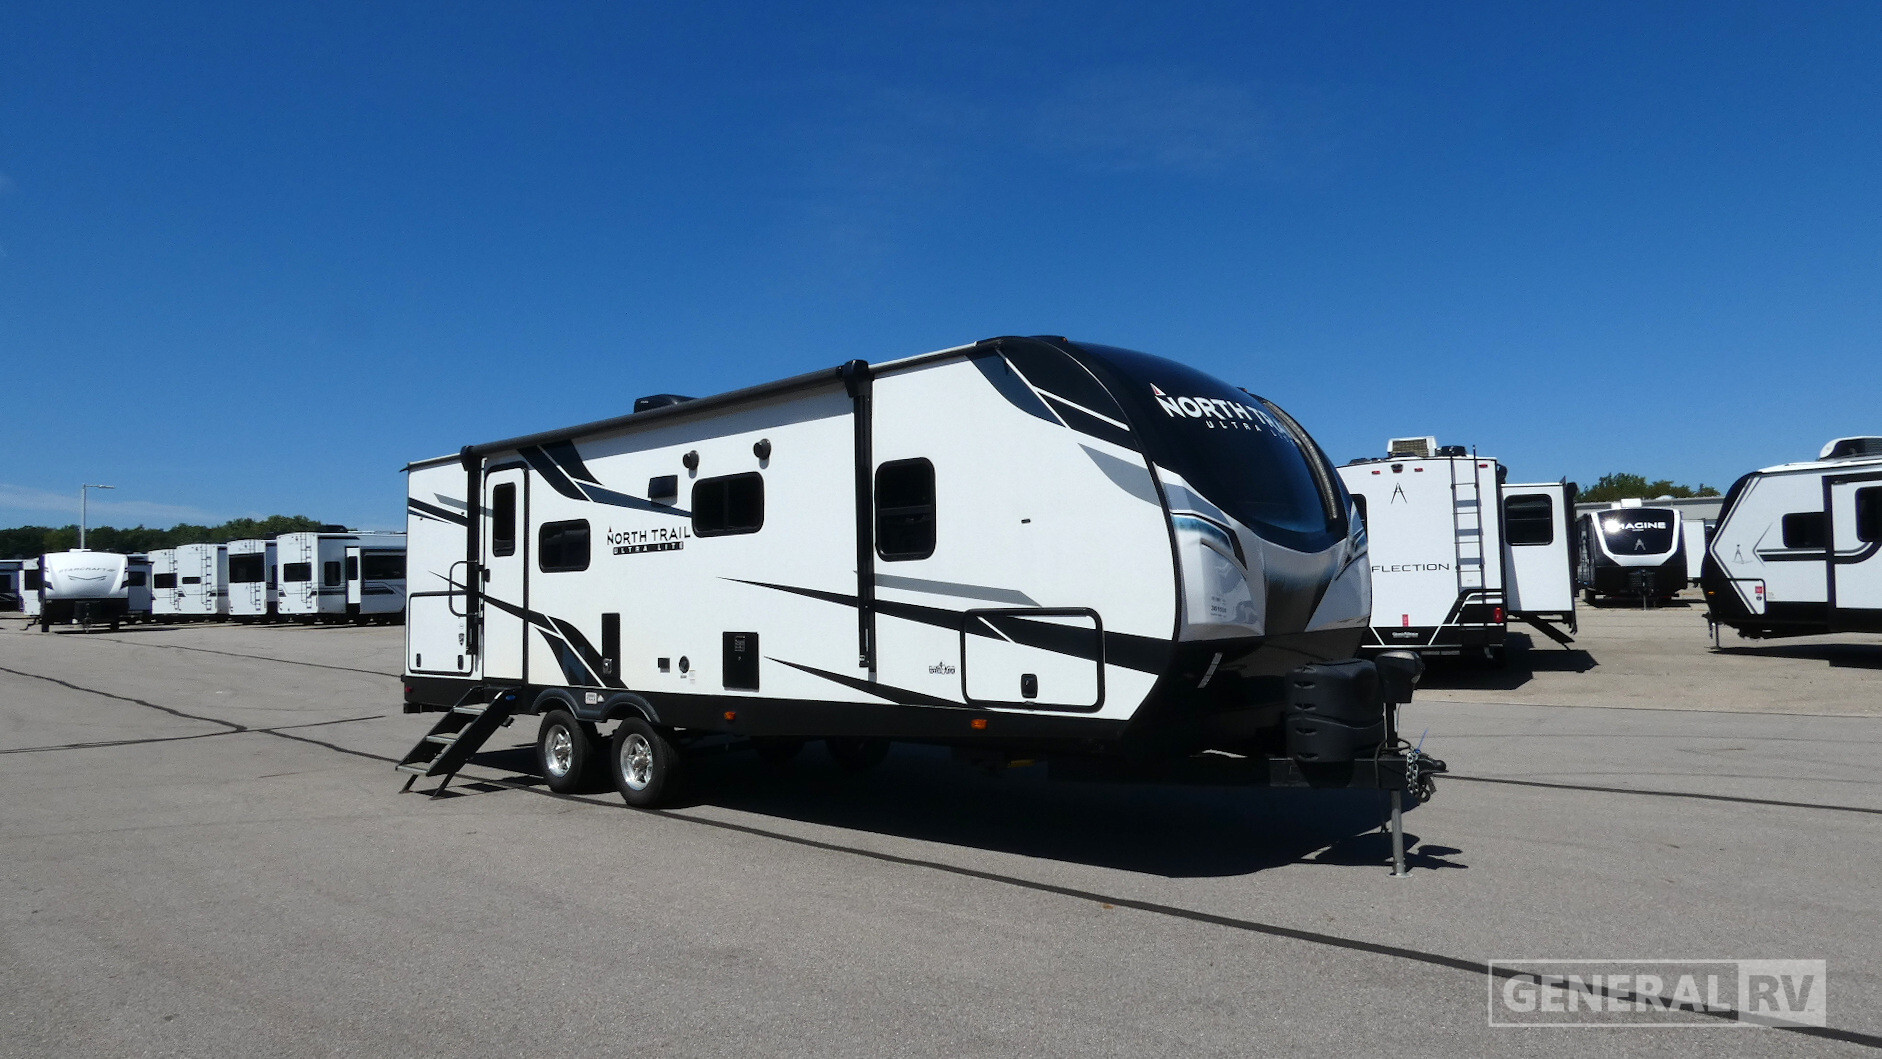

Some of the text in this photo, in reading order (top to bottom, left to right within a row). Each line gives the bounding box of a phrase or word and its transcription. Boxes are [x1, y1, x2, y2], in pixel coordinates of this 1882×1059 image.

[1155, 396, 1253, 420] NORTH
[1206, 420, 1262, 432] ULTRA
[607, 526, 691, 546] NORTH TRAIL
[613, 545, 648, 554] ULTRA
[1371, 563, 1450, 573] FLECTION
